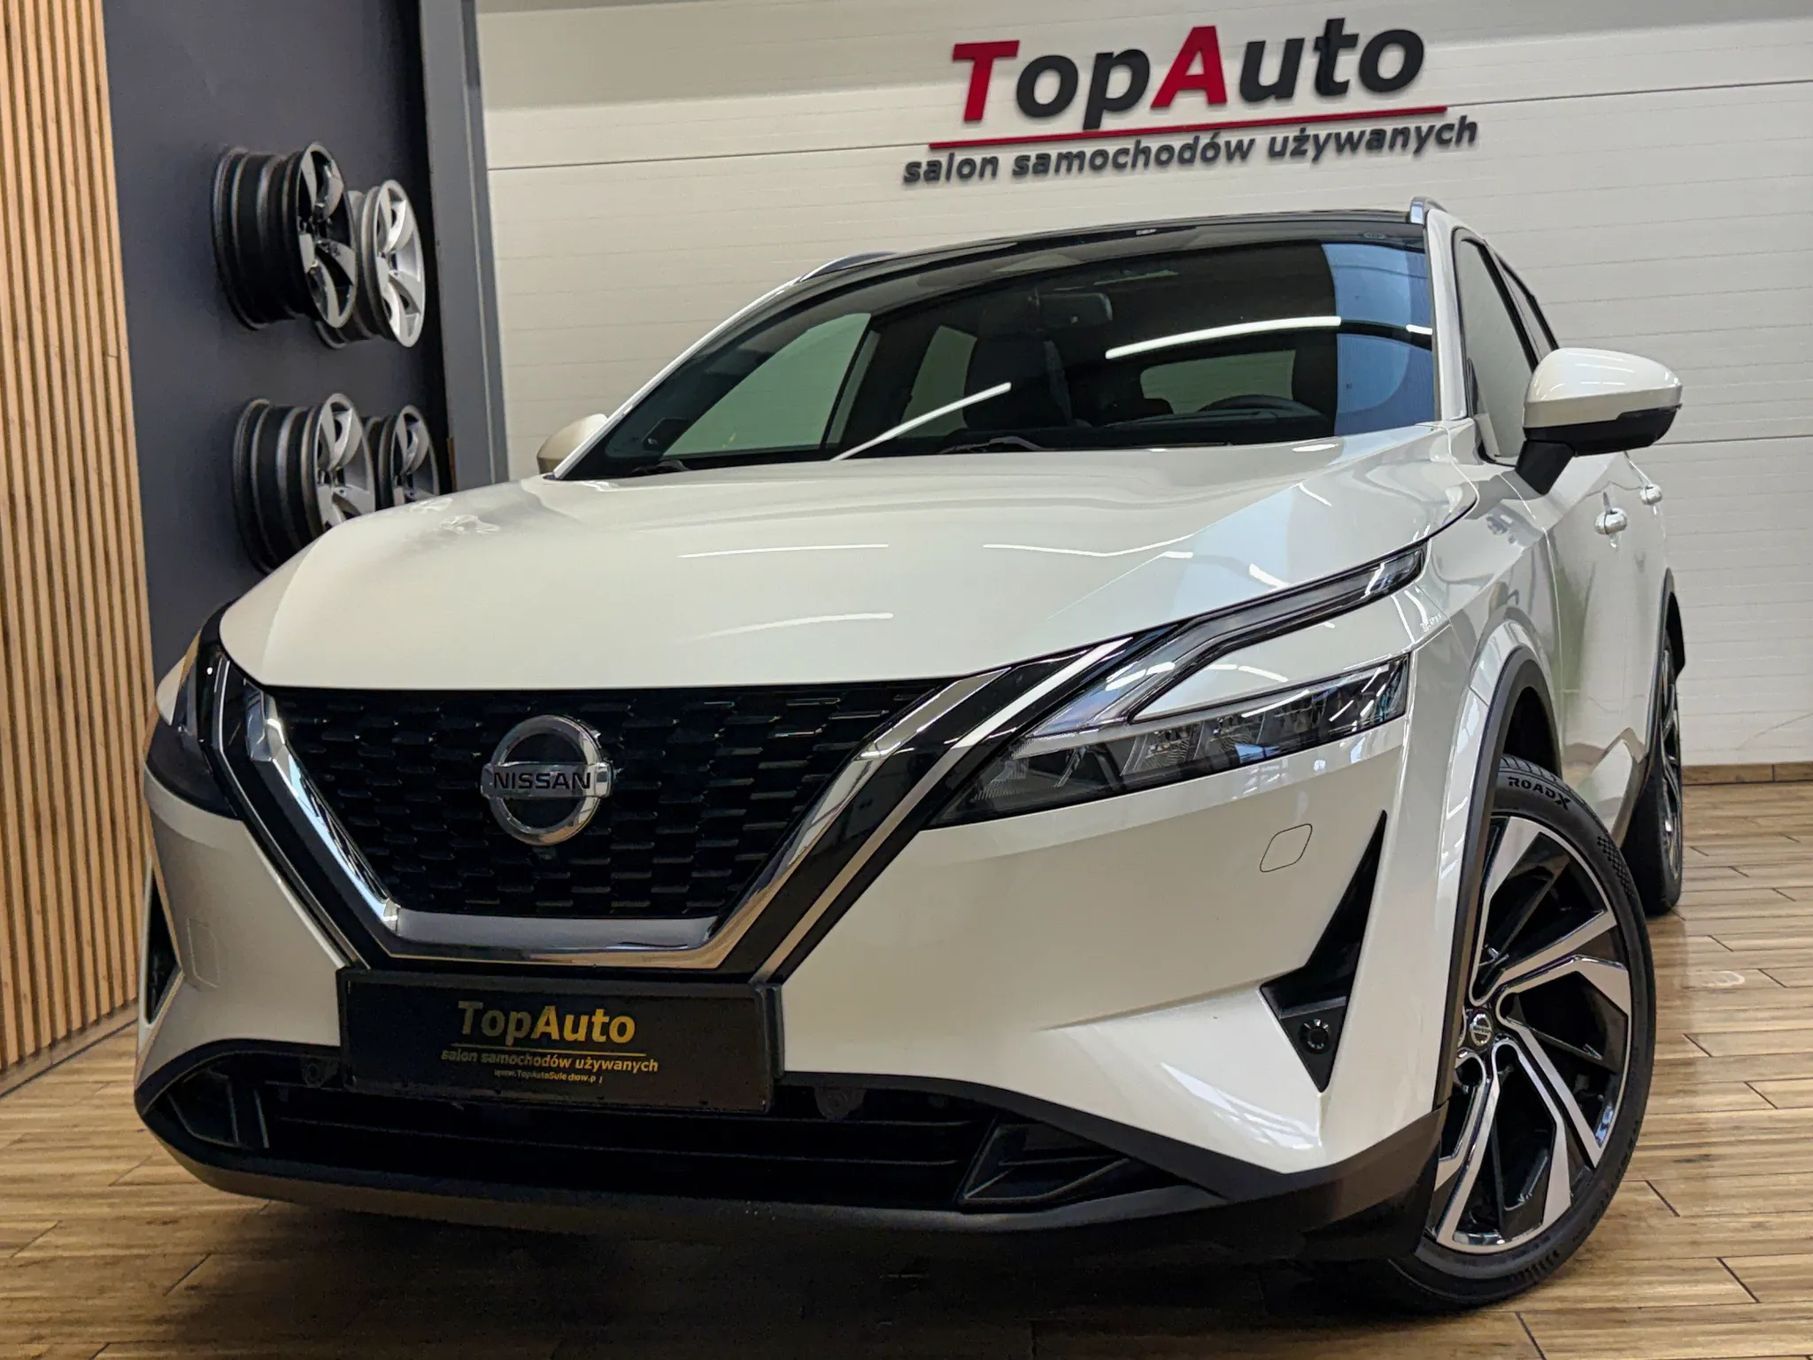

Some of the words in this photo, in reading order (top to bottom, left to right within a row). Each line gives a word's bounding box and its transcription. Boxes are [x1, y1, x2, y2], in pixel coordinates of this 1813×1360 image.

[951, 17, 1425, 131] TopAuto
[903, 152, 999, 184] salon
[1012, 132, 1256, 179] samochodów
[1268, 115, 1478, 165] używanych
[493, 772, 591, 790] NISSAN
[1508, 776, 1571, 811] ROADX
[457, 1000, 636, 1046] TopAuto
[441, 1049, 477, 1063] salon
[481, 1051, 573, 1070] samochodów
[575, 1056, 659, 1074] używanych
